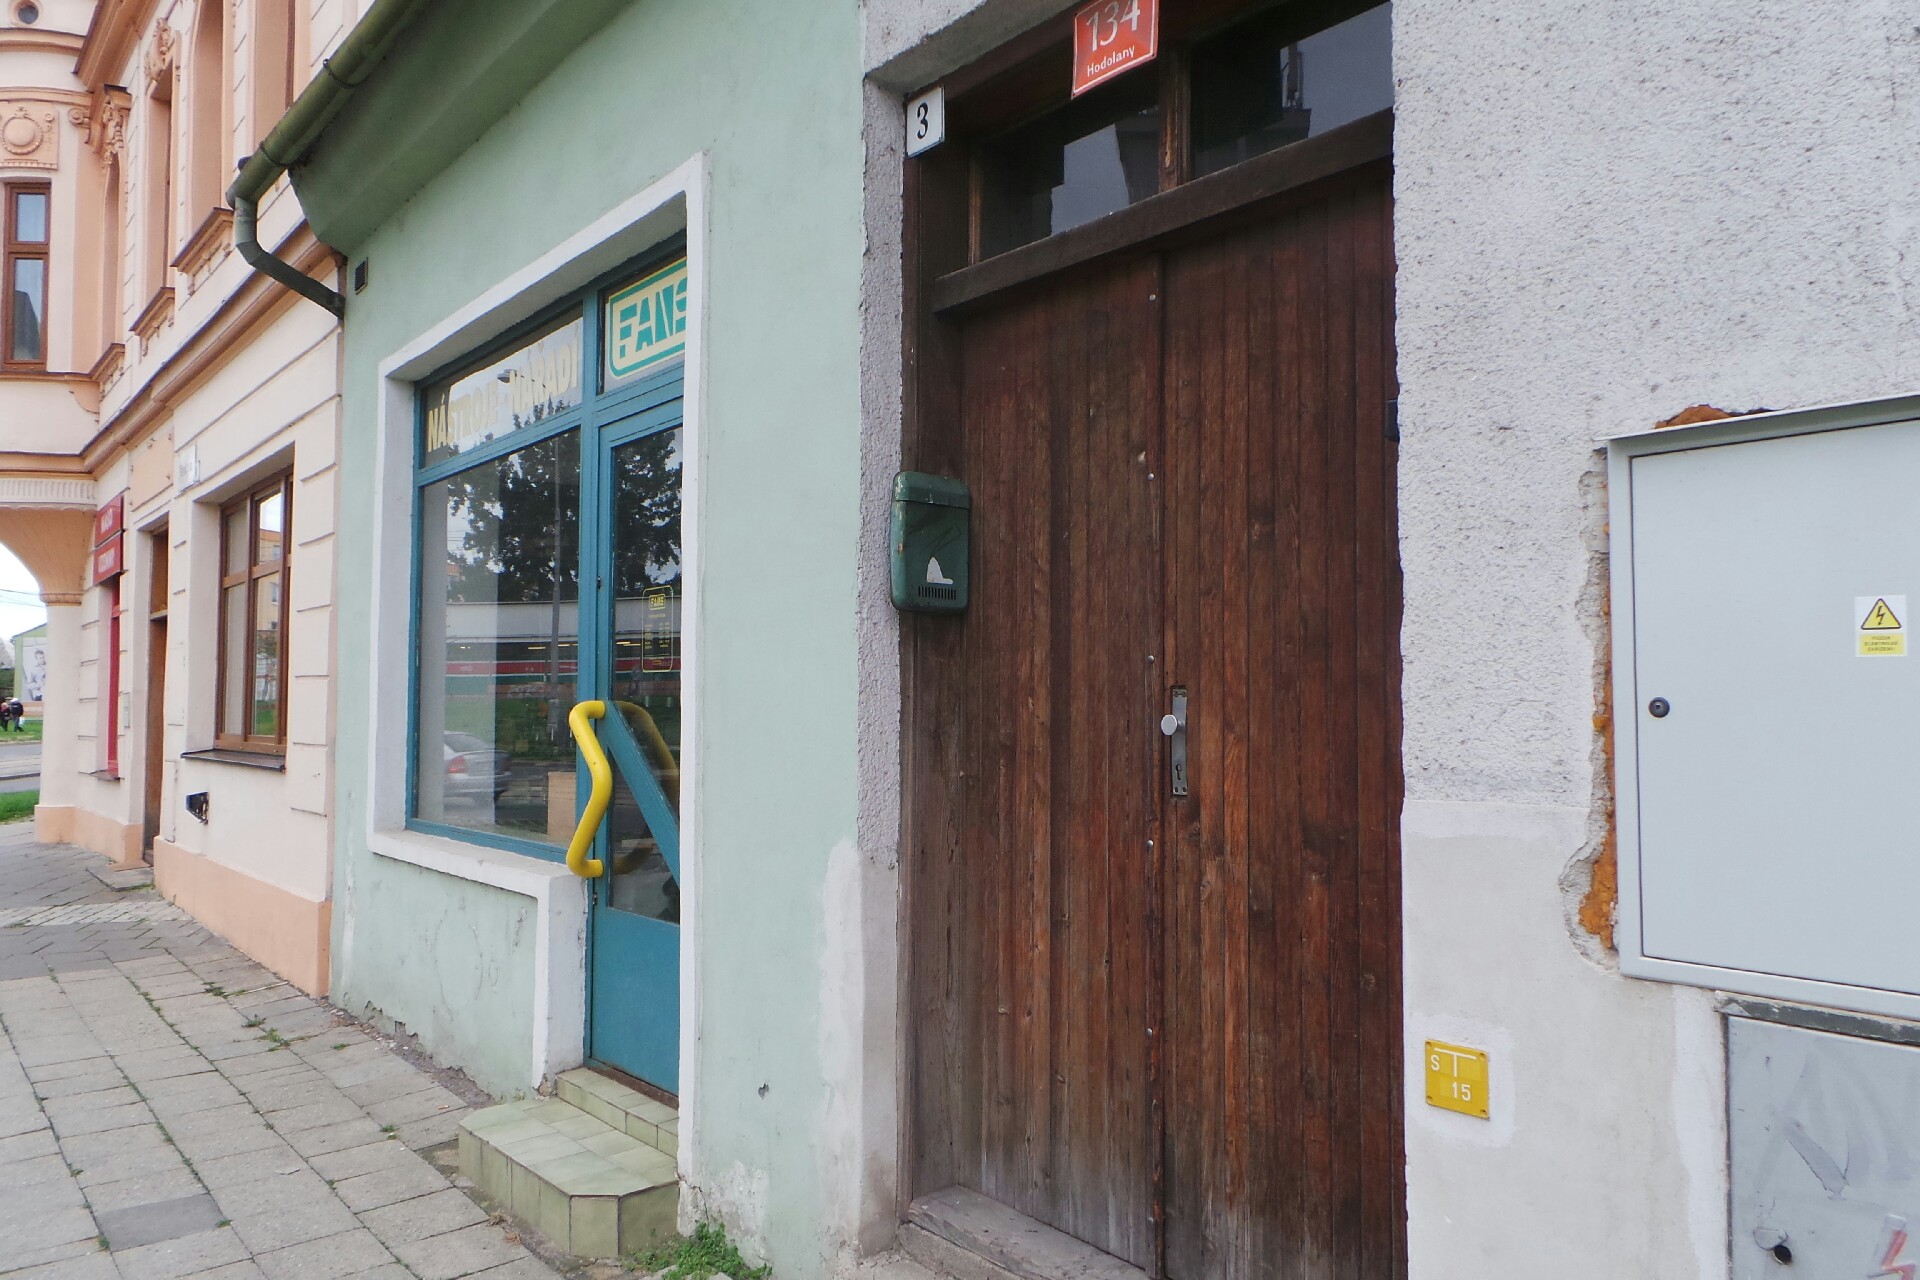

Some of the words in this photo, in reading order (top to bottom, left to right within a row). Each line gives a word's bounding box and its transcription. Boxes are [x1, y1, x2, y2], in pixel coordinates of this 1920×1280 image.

[1086, 0, 1140, 51] 134
[1087, 46, 1135, 76] Hodolany
[917, 102, 928, 139] 3
[1452, 1081, 1471, 1101] 15
